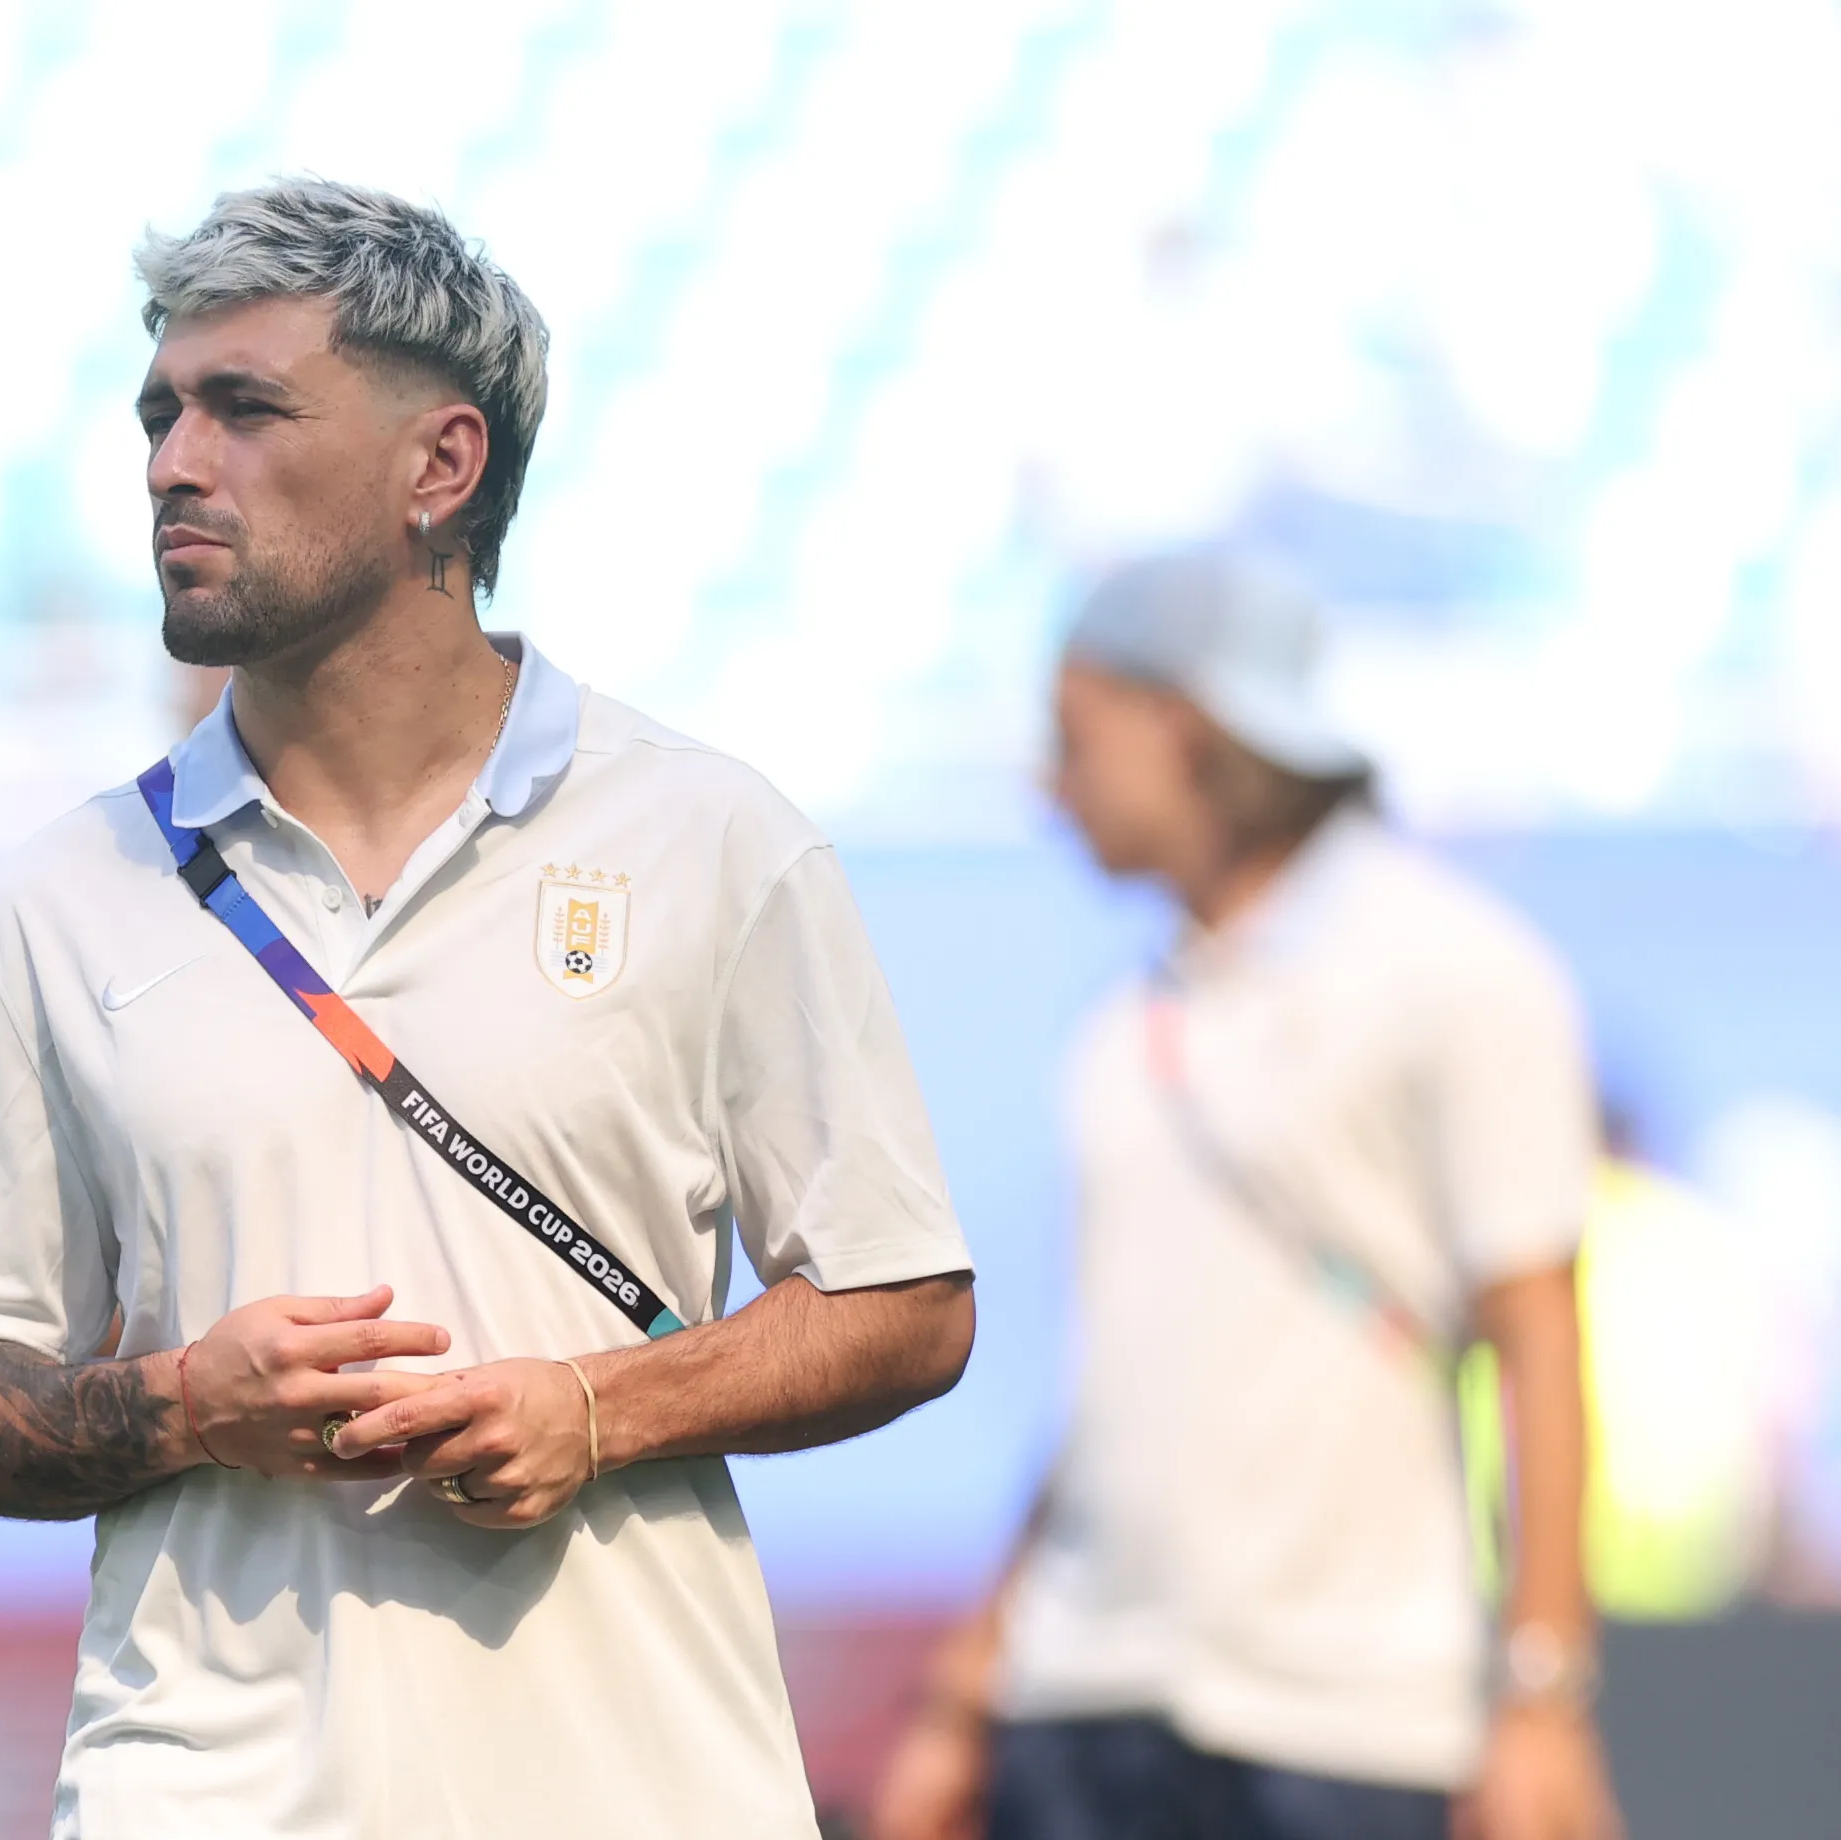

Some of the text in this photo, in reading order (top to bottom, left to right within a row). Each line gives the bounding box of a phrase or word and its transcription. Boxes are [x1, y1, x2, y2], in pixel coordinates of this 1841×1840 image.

[571, 908, 592, 947] AUF
[400, 1089, 641, 1307] FIFA WORLD CUP 2026
